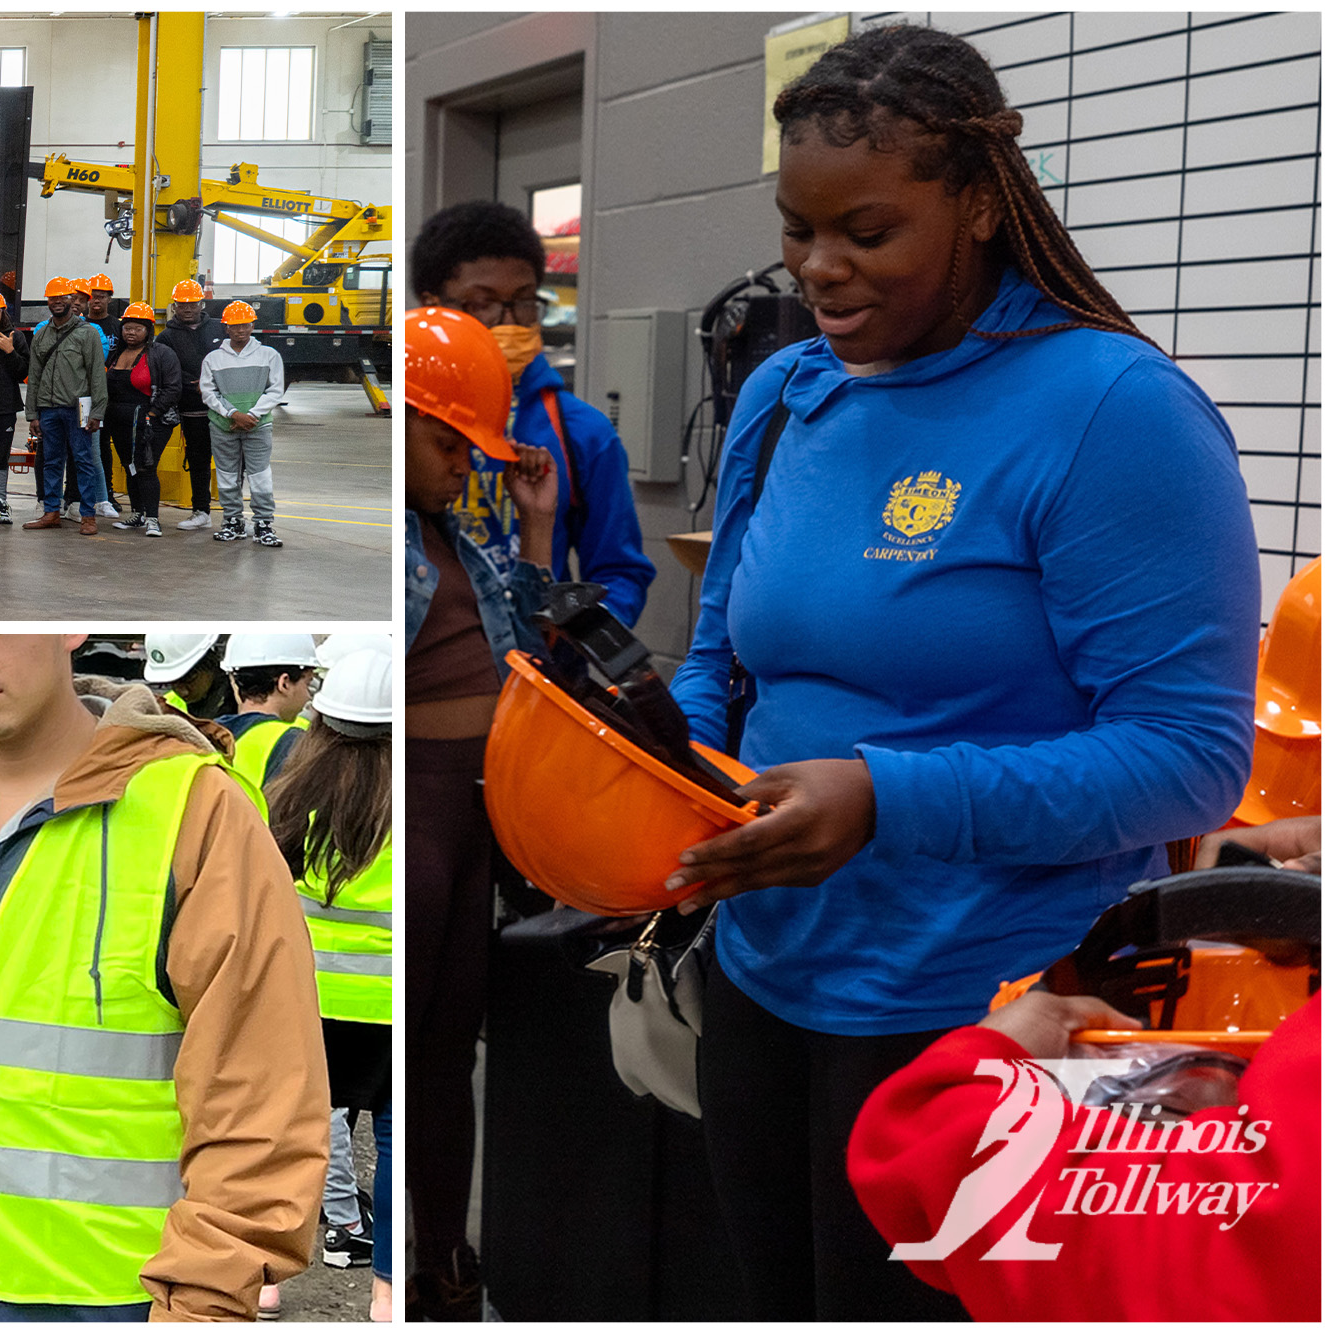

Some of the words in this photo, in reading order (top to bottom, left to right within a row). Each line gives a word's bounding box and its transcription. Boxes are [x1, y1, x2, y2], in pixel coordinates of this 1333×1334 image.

[66, 168, 100, 182] H60
[261, 197, 311, 213] ELLIOTT
[903, 487, 948, 498] SIMEON
[909, 504, 927, 522] C
[882, 531, 935, 545] EXCELLENCE
[863, 547, 939, 562] CARPENTRY
